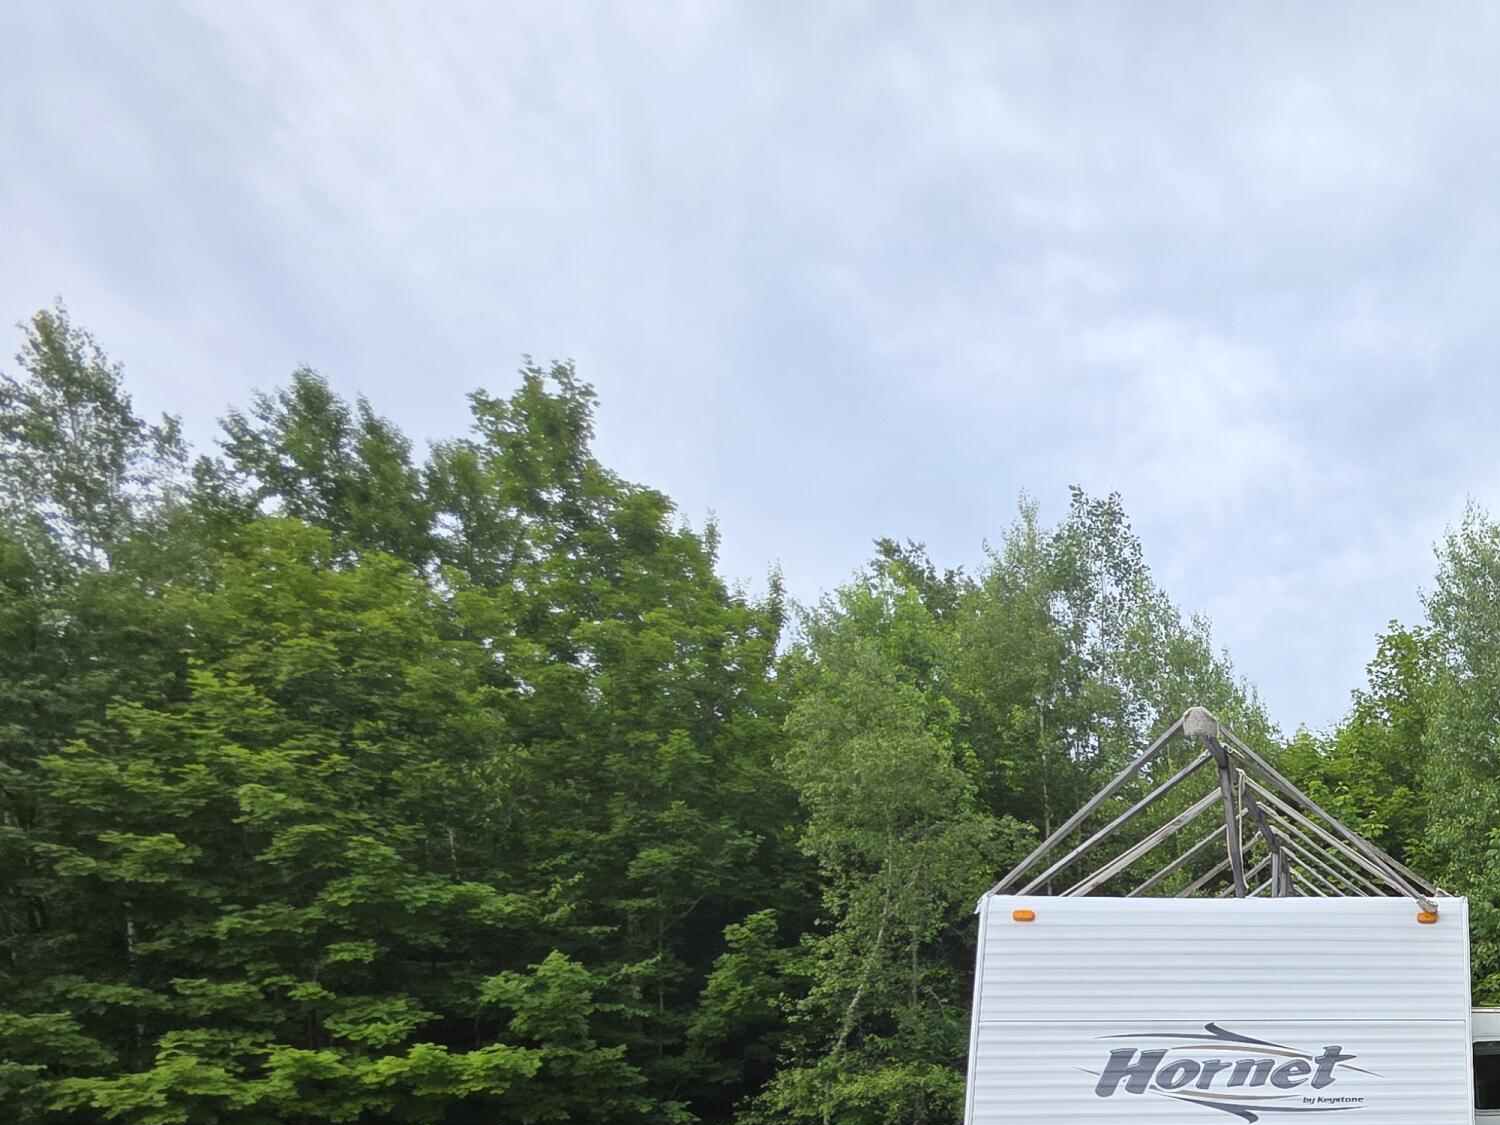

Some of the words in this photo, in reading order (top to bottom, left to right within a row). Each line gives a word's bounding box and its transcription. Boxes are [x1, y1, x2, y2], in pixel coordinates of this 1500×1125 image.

[1095, 1046, 1357, 1097] Hornet
[1303, 1096, 1316, 1104] by
[1317, 1096, 1364, 1105] Keystone
